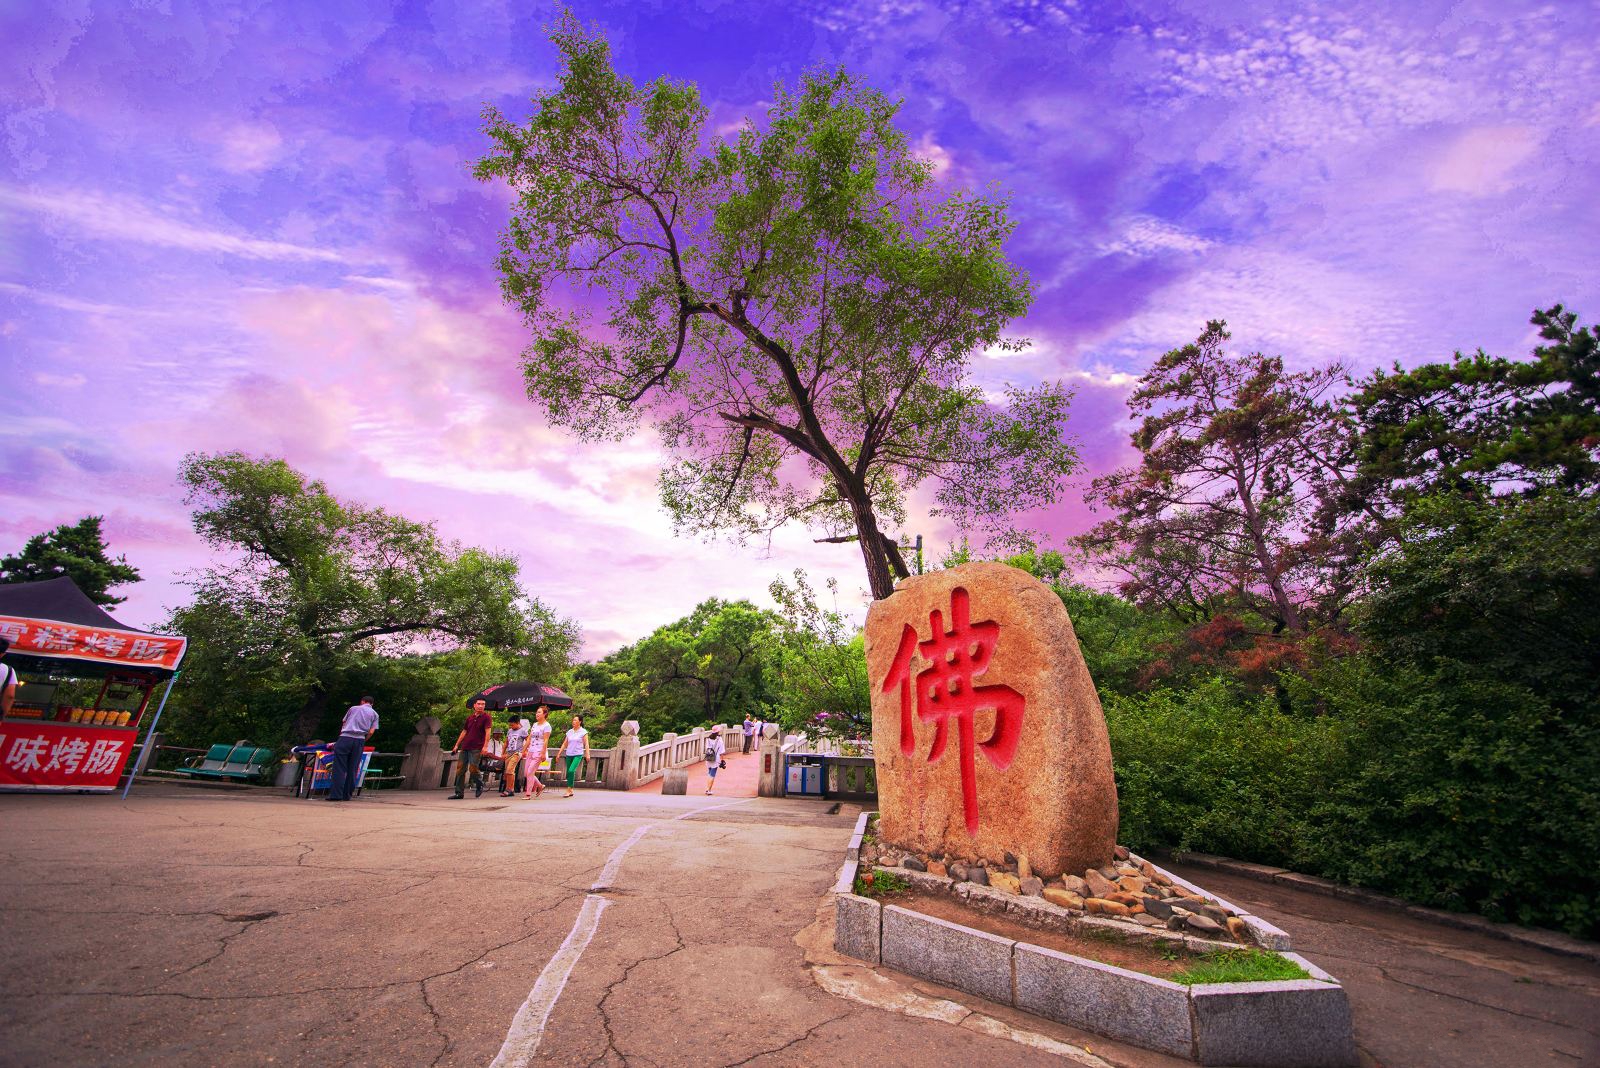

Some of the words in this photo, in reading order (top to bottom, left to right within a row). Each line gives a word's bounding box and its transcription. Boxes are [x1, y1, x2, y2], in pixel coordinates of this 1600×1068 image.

[0, 734, 125, 775] 味烤肠
[883, 587, 1025, 836] 佛
